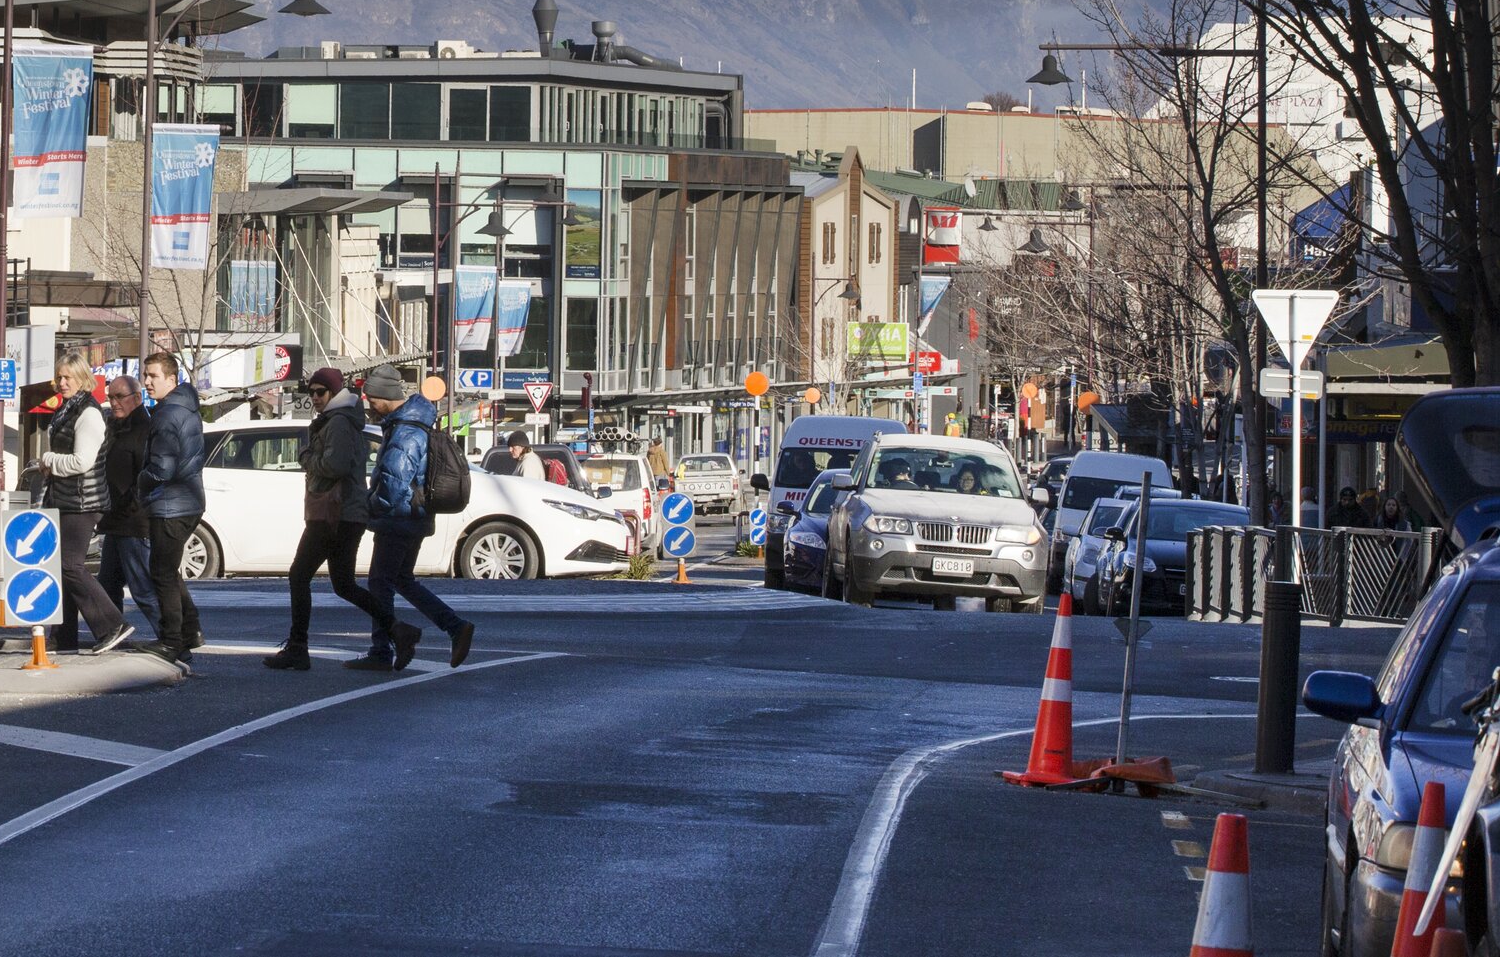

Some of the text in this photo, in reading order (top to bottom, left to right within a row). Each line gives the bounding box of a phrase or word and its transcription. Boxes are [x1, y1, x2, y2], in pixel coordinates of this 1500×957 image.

[17, 78, 65, 89] Queenstown
[26, 86, 66, 101] Winter
[22, 96, 71, 119] Festival
[47, 153, 67, 161] Starts
[68, 152, 84, 160] Here
[162, 157, 197, 170] Winter
[160, 166, 200, 185] Festival
[1, 360, 9, 371] P
[1, 372, 9, 381] 30
[477, 371, 489, 386] P
[294, 394, 311, 410] 36
[682, 482, 726, 491] TOYOTA
[934, 561, 971, 572] GKC810
